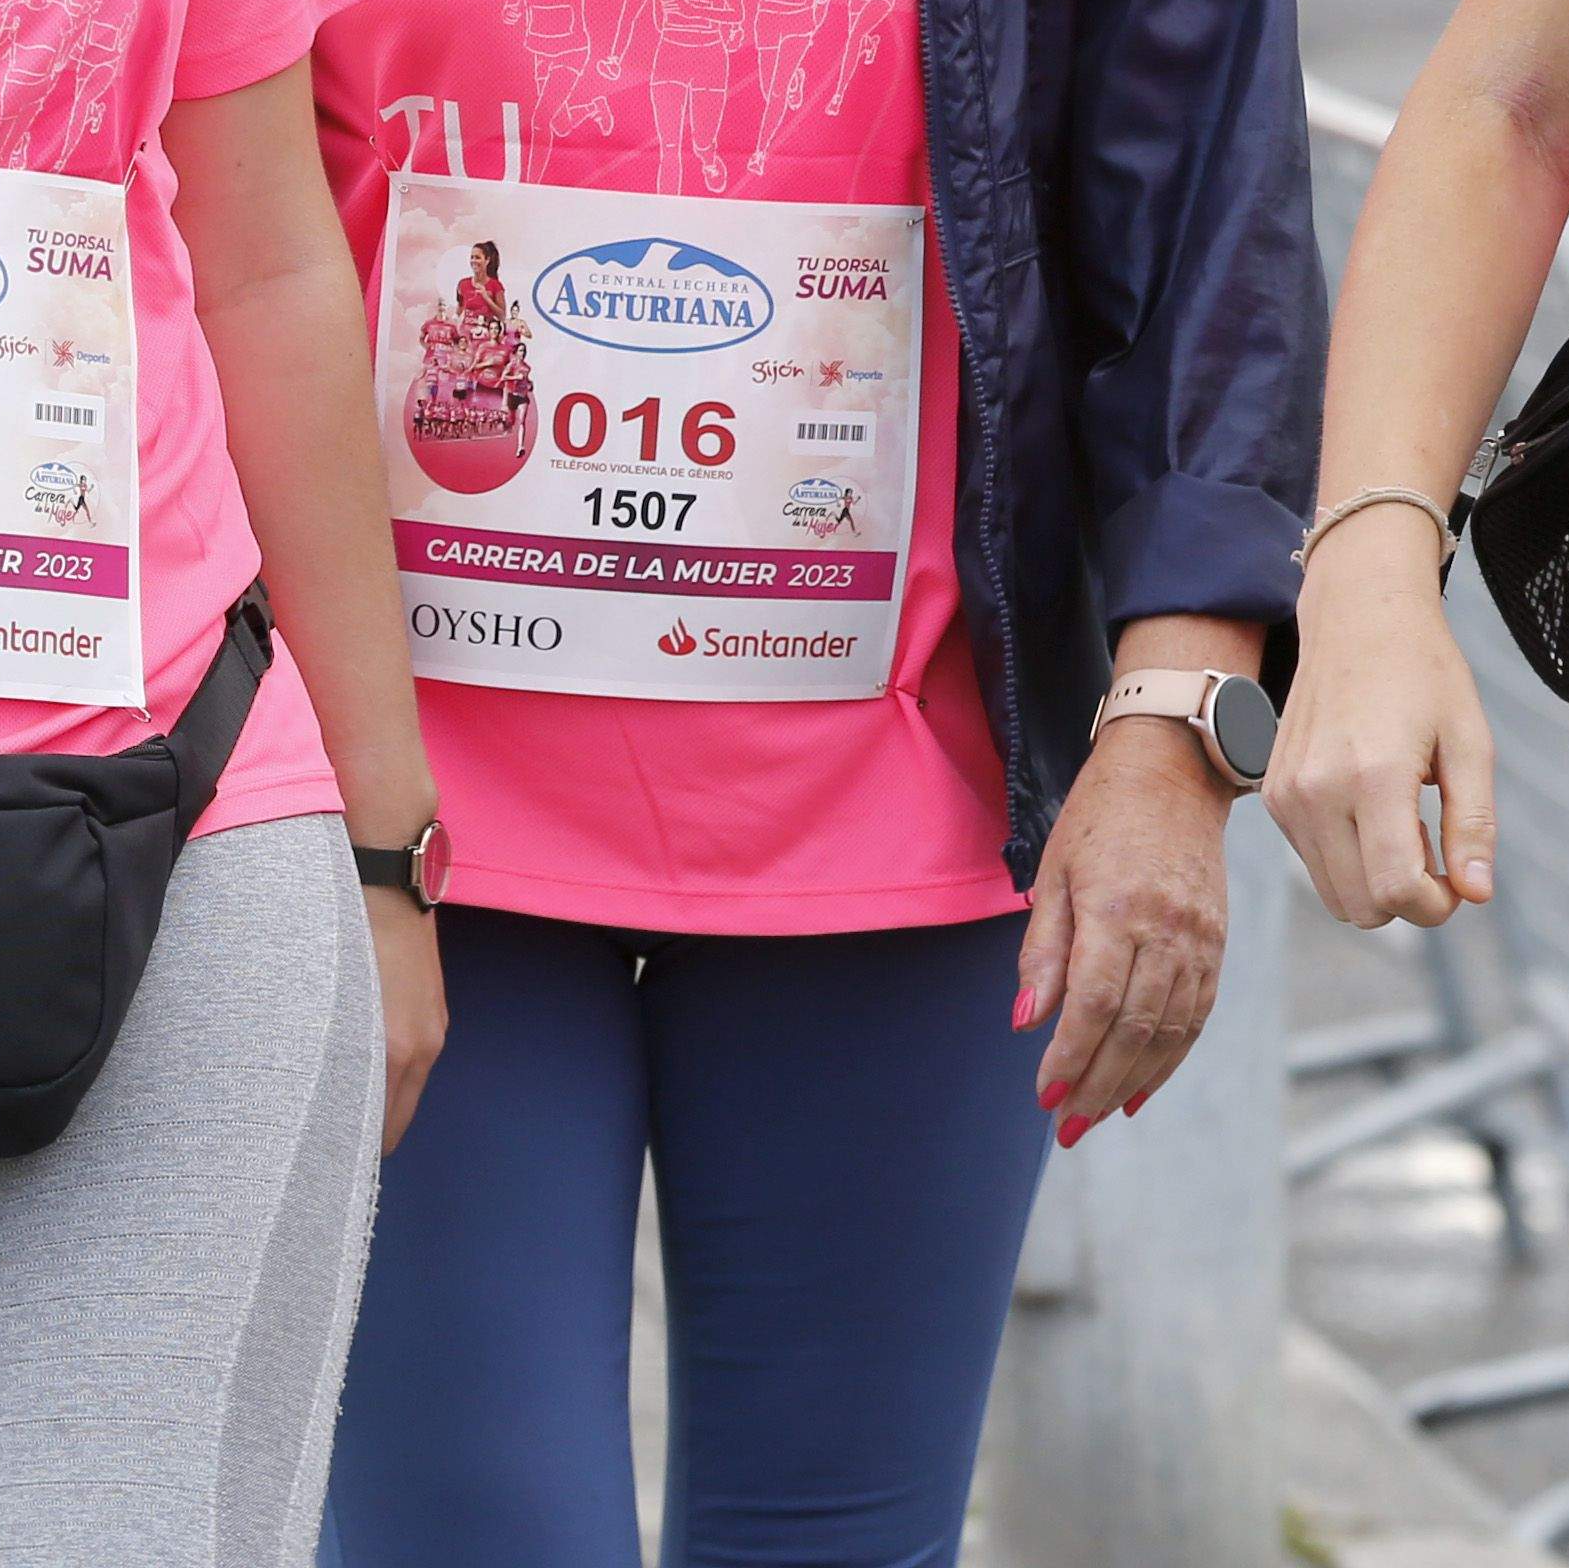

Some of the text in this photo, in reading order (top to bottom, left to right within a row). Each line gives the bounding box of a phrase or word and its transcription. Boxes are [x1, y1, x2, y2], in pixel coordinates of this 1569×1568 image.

[27, 229, 115, 252] TU DORSAL
[27, 247, 113, 281] SUMA
[797, 258, 890, 273] TU DORSAL
[589, 273, 749, 294] CENTRAL LECHERA
[795, 274, 887, 301] SUMA
[549, 273, 755, 328] ASTURIANA
[77, 349, 111, 365] Deporte
[846, 368, 883, 381] Deporte
[552, 392, 736, 467] 016
[550, 458, 733, 480] TELÉFONO VIOLENCIA DE GÉNERO
[25, 487, 66, 503] Carrera
[583, 487, 698, 531] 1507
[783, 503, 827, 516] Carrera
[33, 552, 93, 580] 2023
[426, 539, 853, 587] CARRERA DE LA MUJER 2023
[411, 604, 563, 651] OYSHO
[704, 628, 857, 658] Santander
